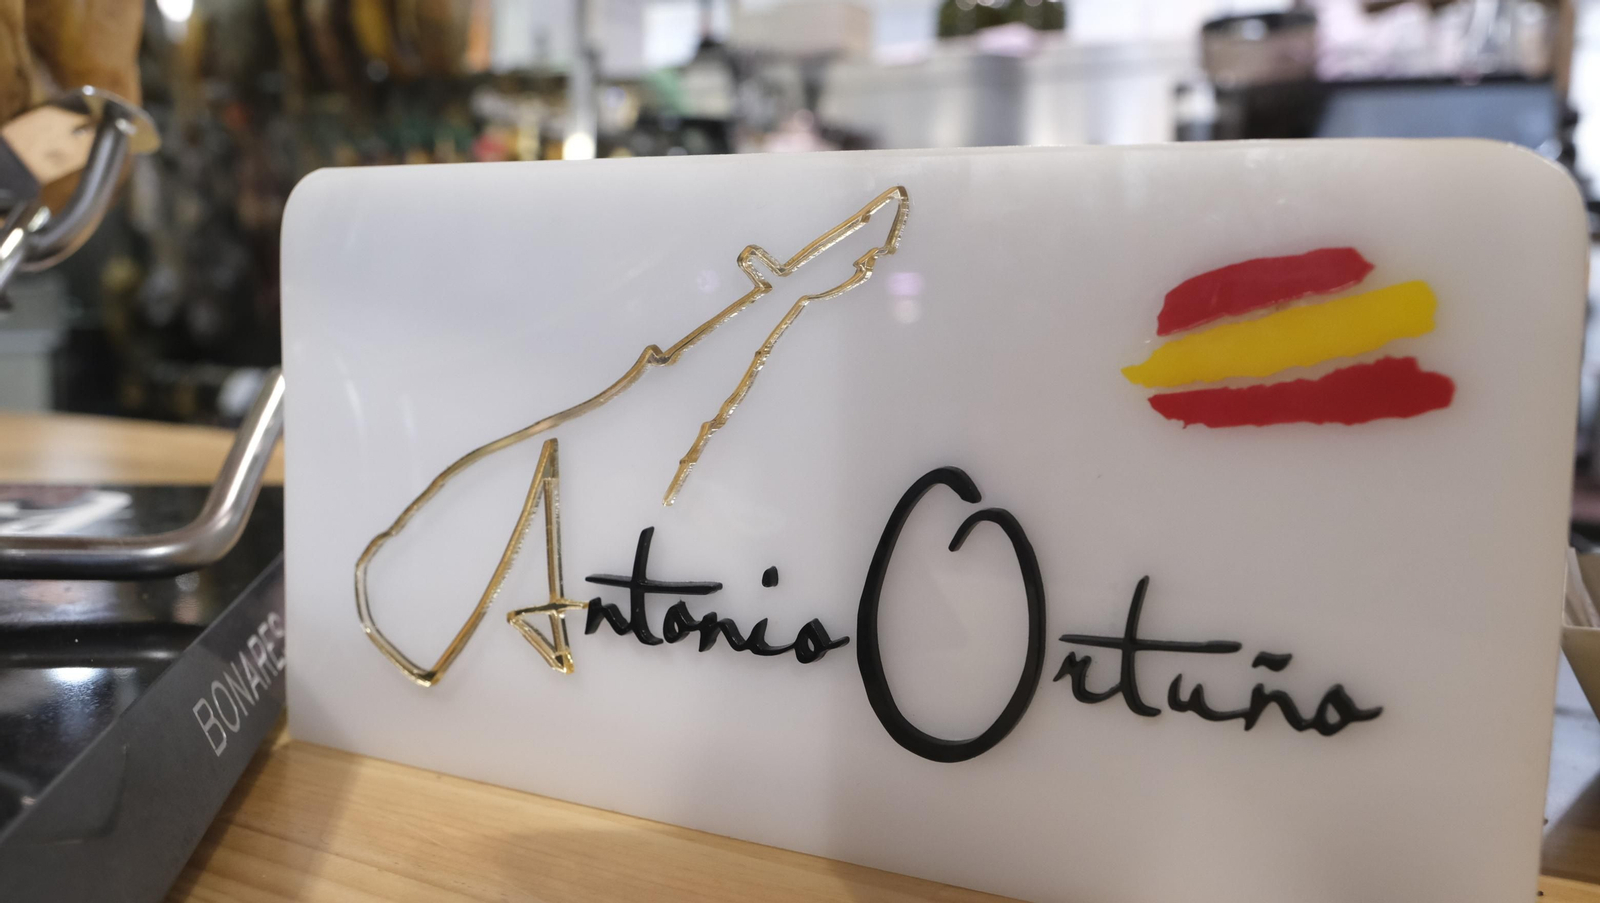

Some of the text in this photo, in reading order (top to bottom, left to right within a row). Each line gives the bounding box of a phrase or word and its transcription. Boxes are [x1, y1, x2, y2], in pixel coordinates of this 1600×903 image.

[192, 611, 285, 757] BONARES
[424, 438, 1383, 763] Antonio Ortuño
